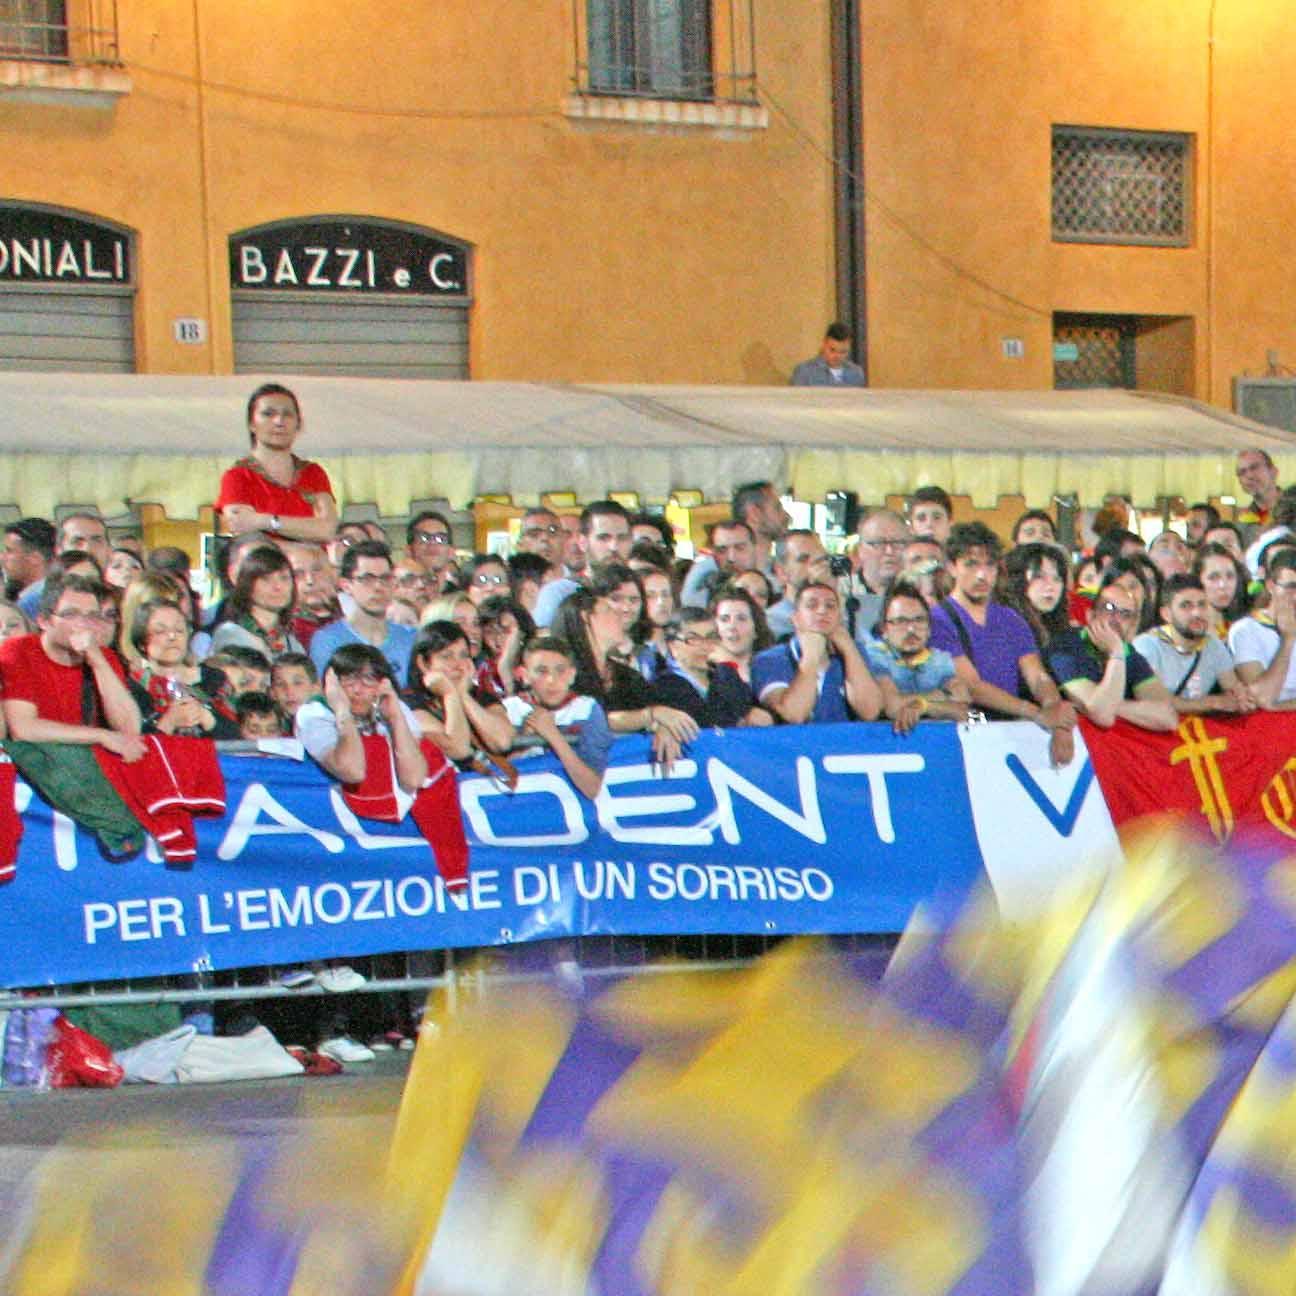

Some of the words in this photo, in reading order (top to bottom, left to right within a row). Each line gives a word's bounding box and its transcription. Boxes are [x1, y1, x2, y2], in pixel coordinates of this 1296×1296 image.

[0, 238, 124, 279] NIALI
[240, 246, 376, 288] BAZZI
[393, 268, 411, 288] e
[14, 752, 926, 872] IALDENT
[84, 897, 187, 944] PER
[200, 870, 503, 935] L'EMOZIONE
[514, 863, 562, 906] DI
[574, 861, 637, 900] UN
[648, 862, 835, 902] SORRISO
